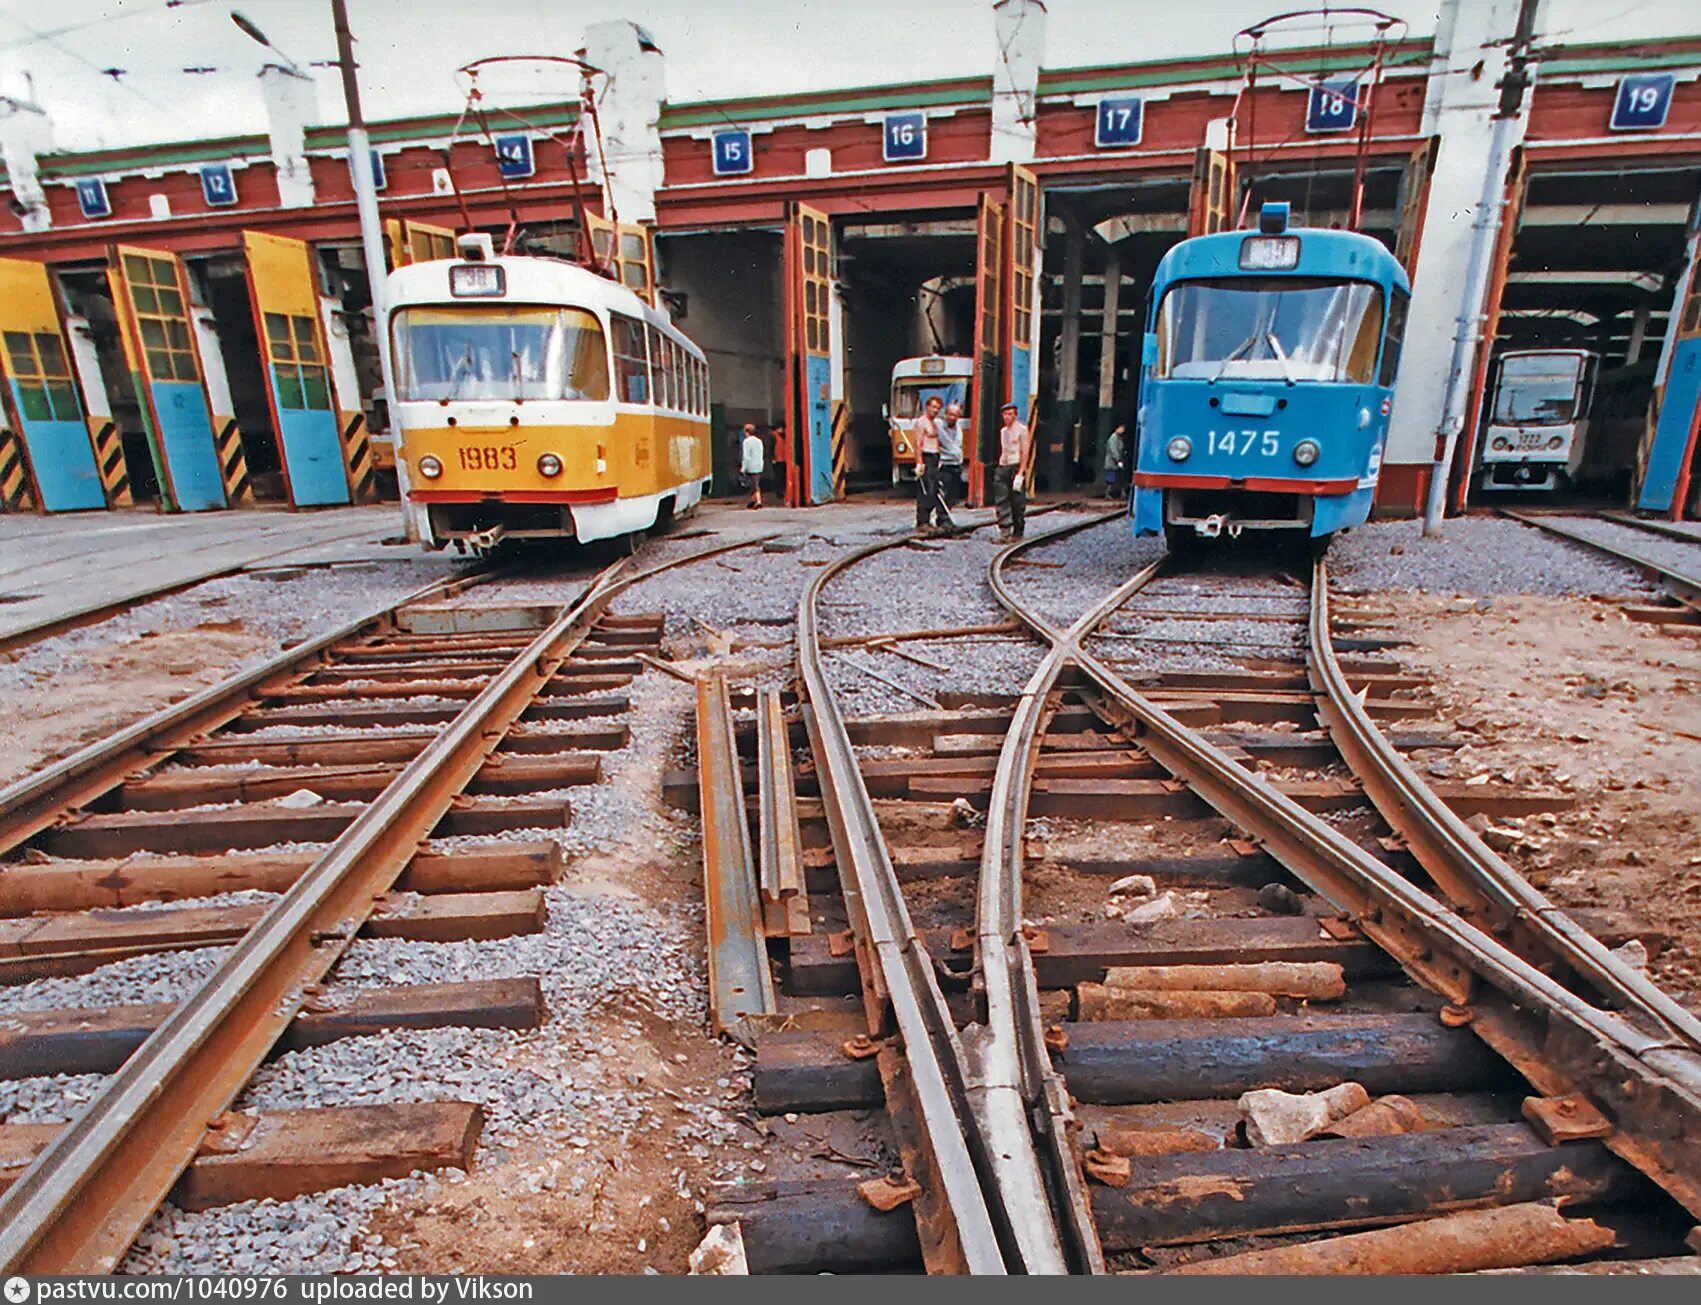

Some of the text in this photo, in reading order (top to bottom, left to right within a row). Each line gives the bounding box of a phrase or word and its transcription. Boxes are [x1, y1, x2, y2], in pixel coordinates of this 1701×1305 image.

[1320, 92, 1344, 116] 18
[1628, 87, 1658, 113] 19
[1105, 108, 1132, 131] 17
[891, 123, 914, 146] 16
[724, 142, 742, 161] 15
[207, 175, 226, 194] 12
[82, 188, 99, 205] 11
[1208, 430, 1280, 456] 1475
[458, 446, 517, 470] 1983
